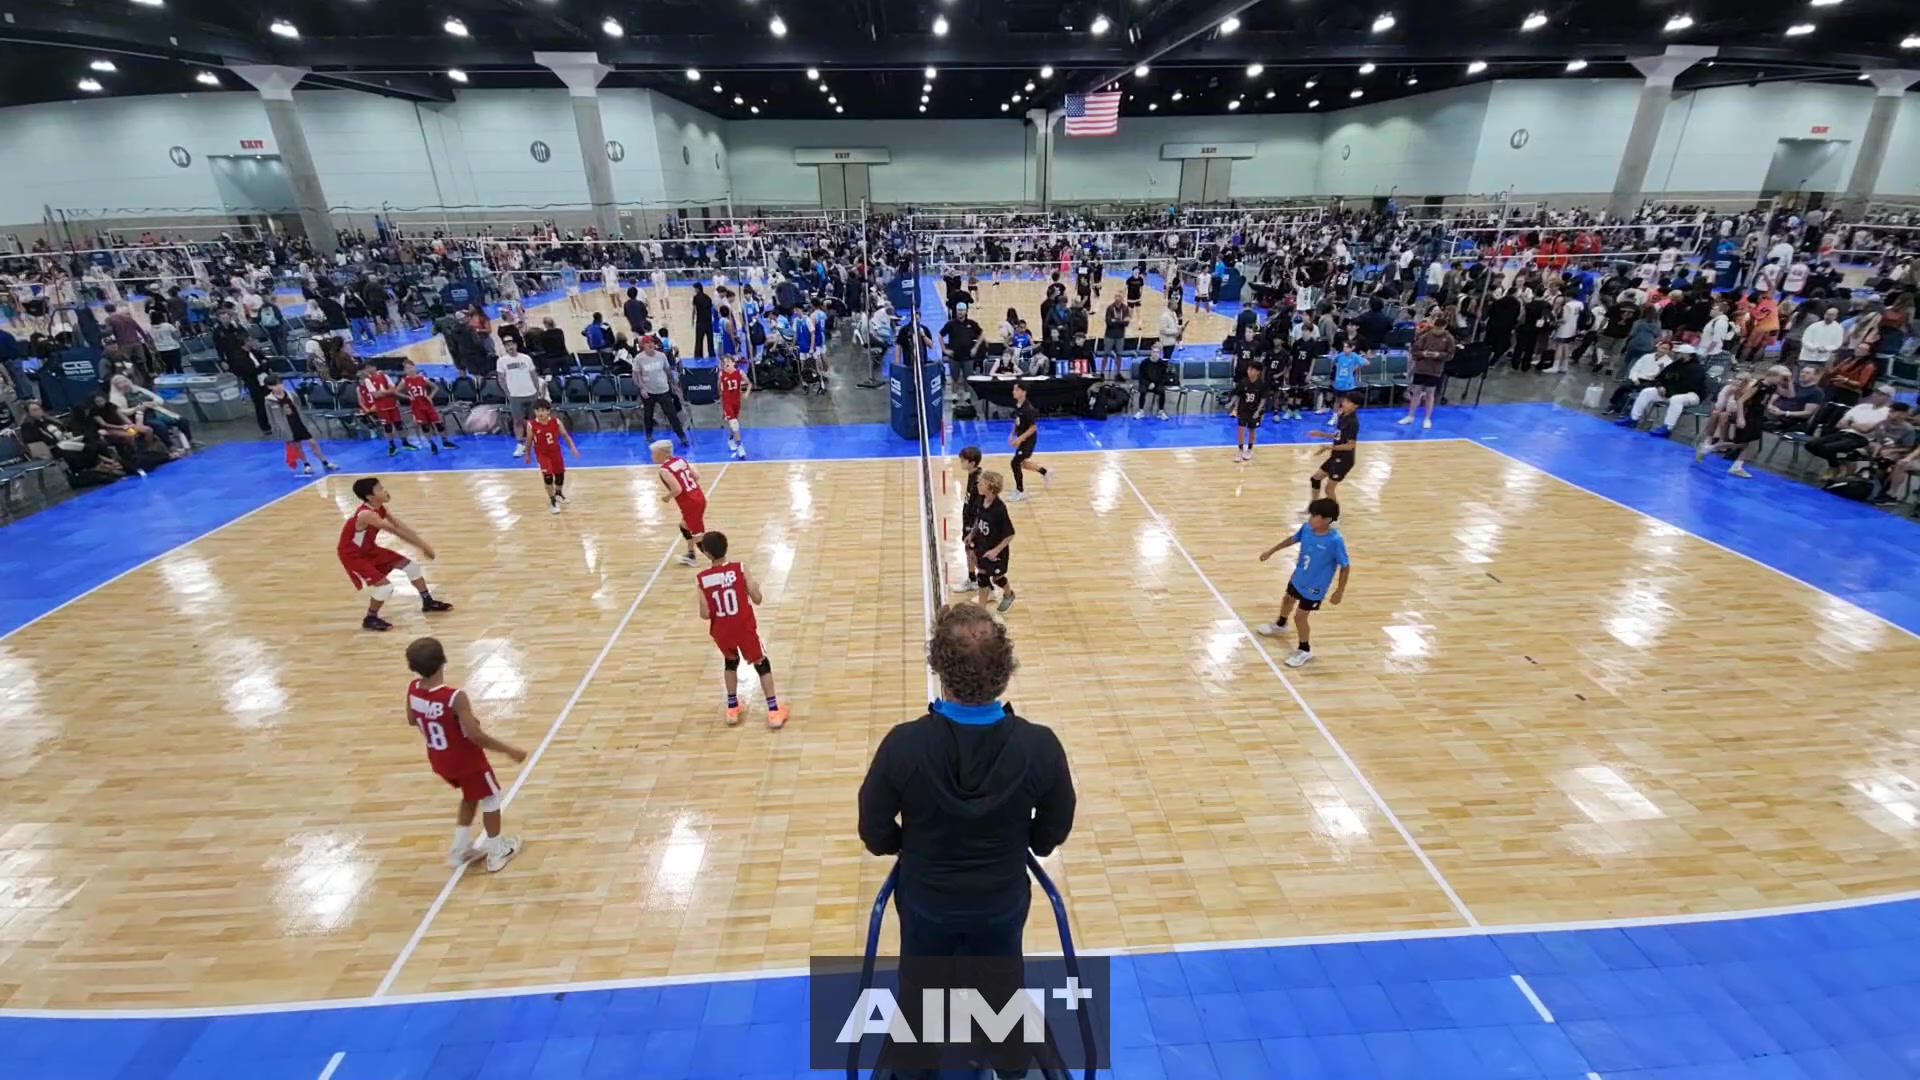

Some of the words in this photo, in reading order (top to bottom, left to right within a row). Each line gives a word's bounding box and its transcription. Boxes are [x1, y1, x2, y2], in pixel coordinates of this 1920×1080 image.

[240, 139, 264, 149] EXIT
[924, 234, 933, 242] 25
[189, 245, 199, 253] 23
[465, 241, 476, 249] 24
[1270, 360, 1280, 369] 67
[727, 379, 738, 391] 13
[1245, 392, 1255, 403] 39
[545, 432, 554, 445] 2
[680, 469, 697, 492] 15
[978, 519, 990, 536] 45
[1303, 555, 1311, 571] 3
[722, 571, 736, 585] MB
[712, 588, 739, 617] 10
[428, 701, 444, 716] MB
[416, 717, 448, 751] 18
